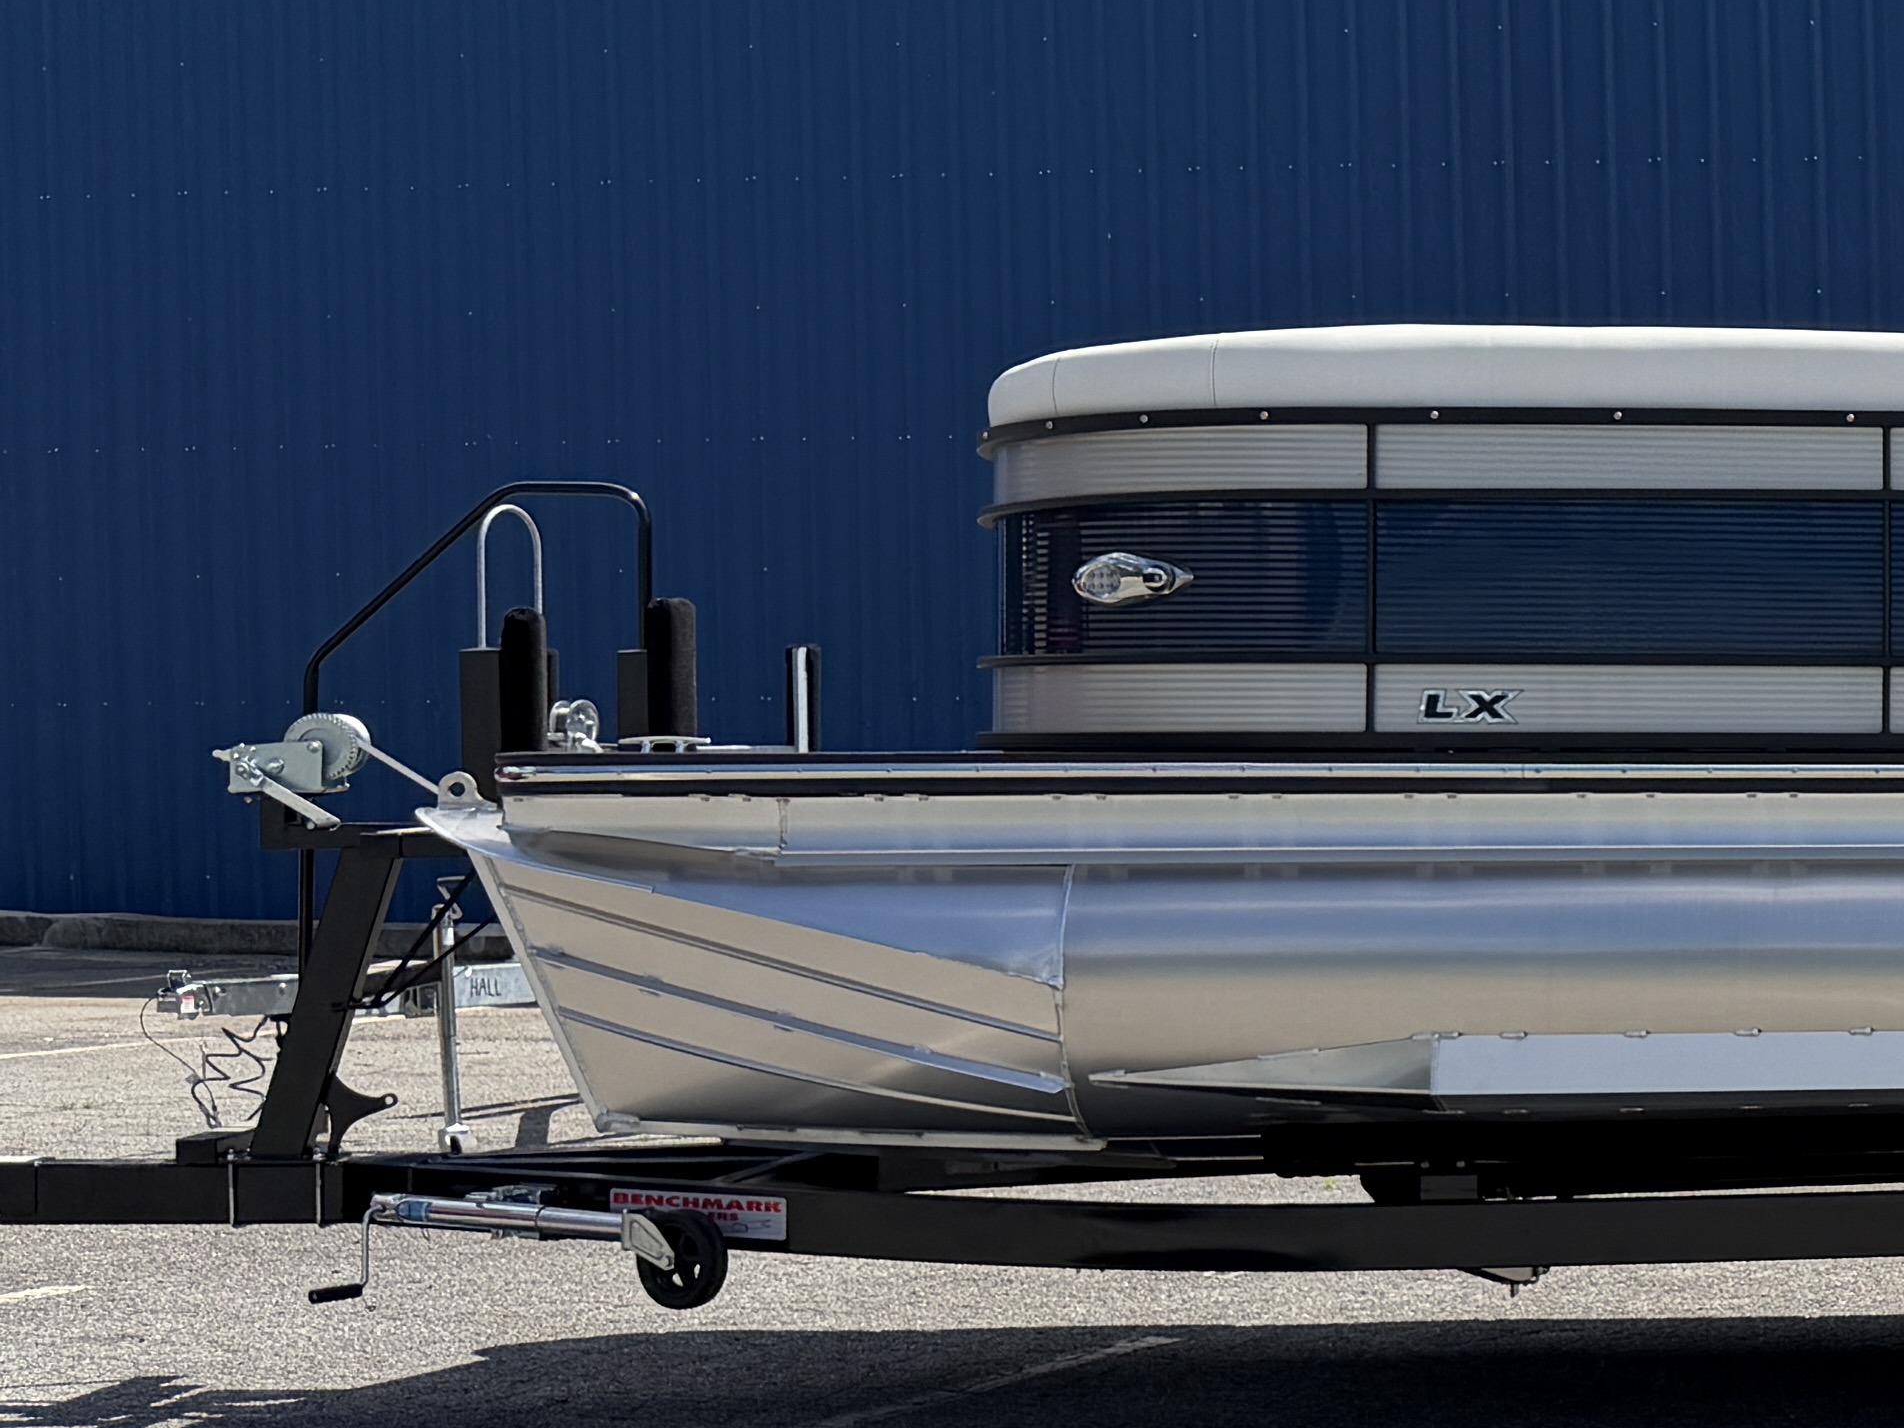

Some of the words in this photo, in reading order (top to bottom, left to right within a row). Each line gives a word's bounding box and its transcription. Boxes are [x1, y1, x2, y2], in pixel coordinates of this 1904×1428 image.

[1417, 688, 1525, 725] LX
[469, 977, 502, 998] HALL
[612, 1192, 783, 1213] BENCHMARK
